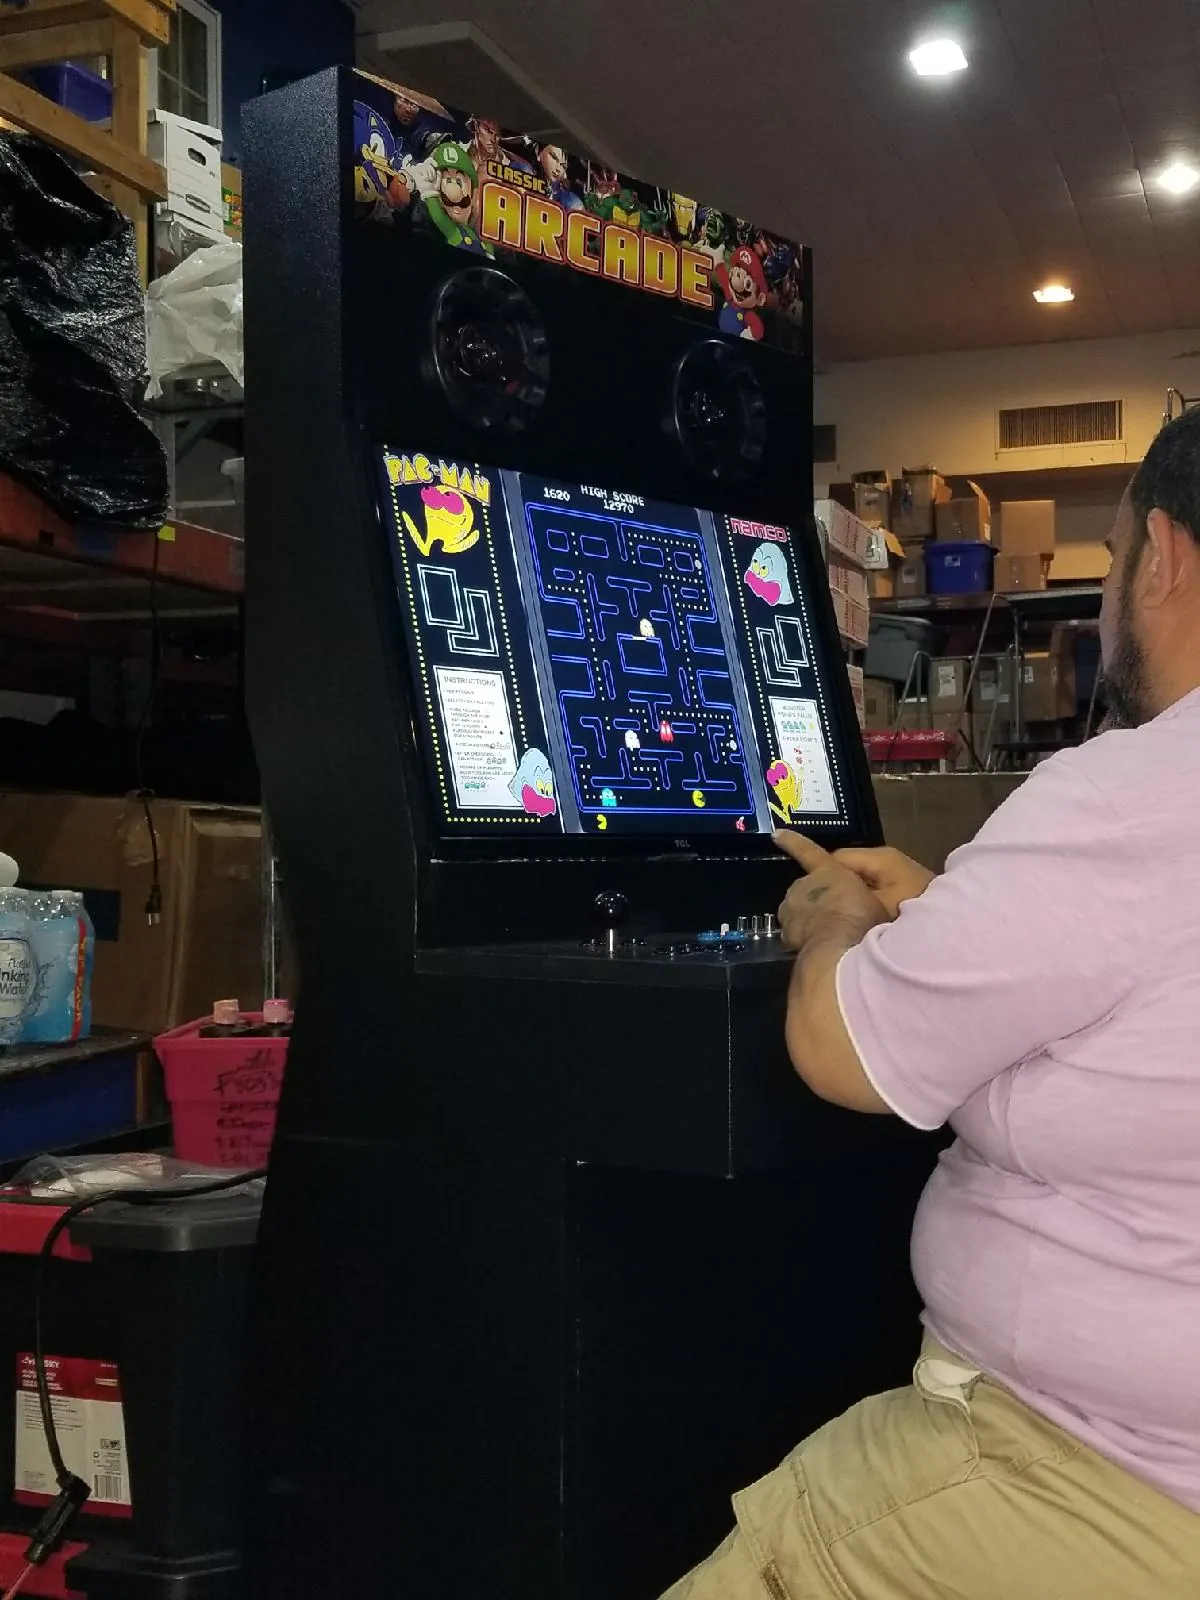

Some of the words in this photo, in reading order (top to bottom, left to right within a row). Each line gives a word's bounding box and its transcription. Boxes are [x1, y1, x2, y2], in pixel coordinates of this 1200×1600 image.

[487, 160, 547, 195] CLASSIC
[480, 182, 715, 308] ARCADE
[383, 454, 491, 507] PAC-MAN
[543, 486, 571, 502] 1620
[580, 484, 608, 499] HIGH
[612, 491, 645, 507] SCORE
[603, 499, 634, 514] 12970
[674, 839, 691, 848] TCL
